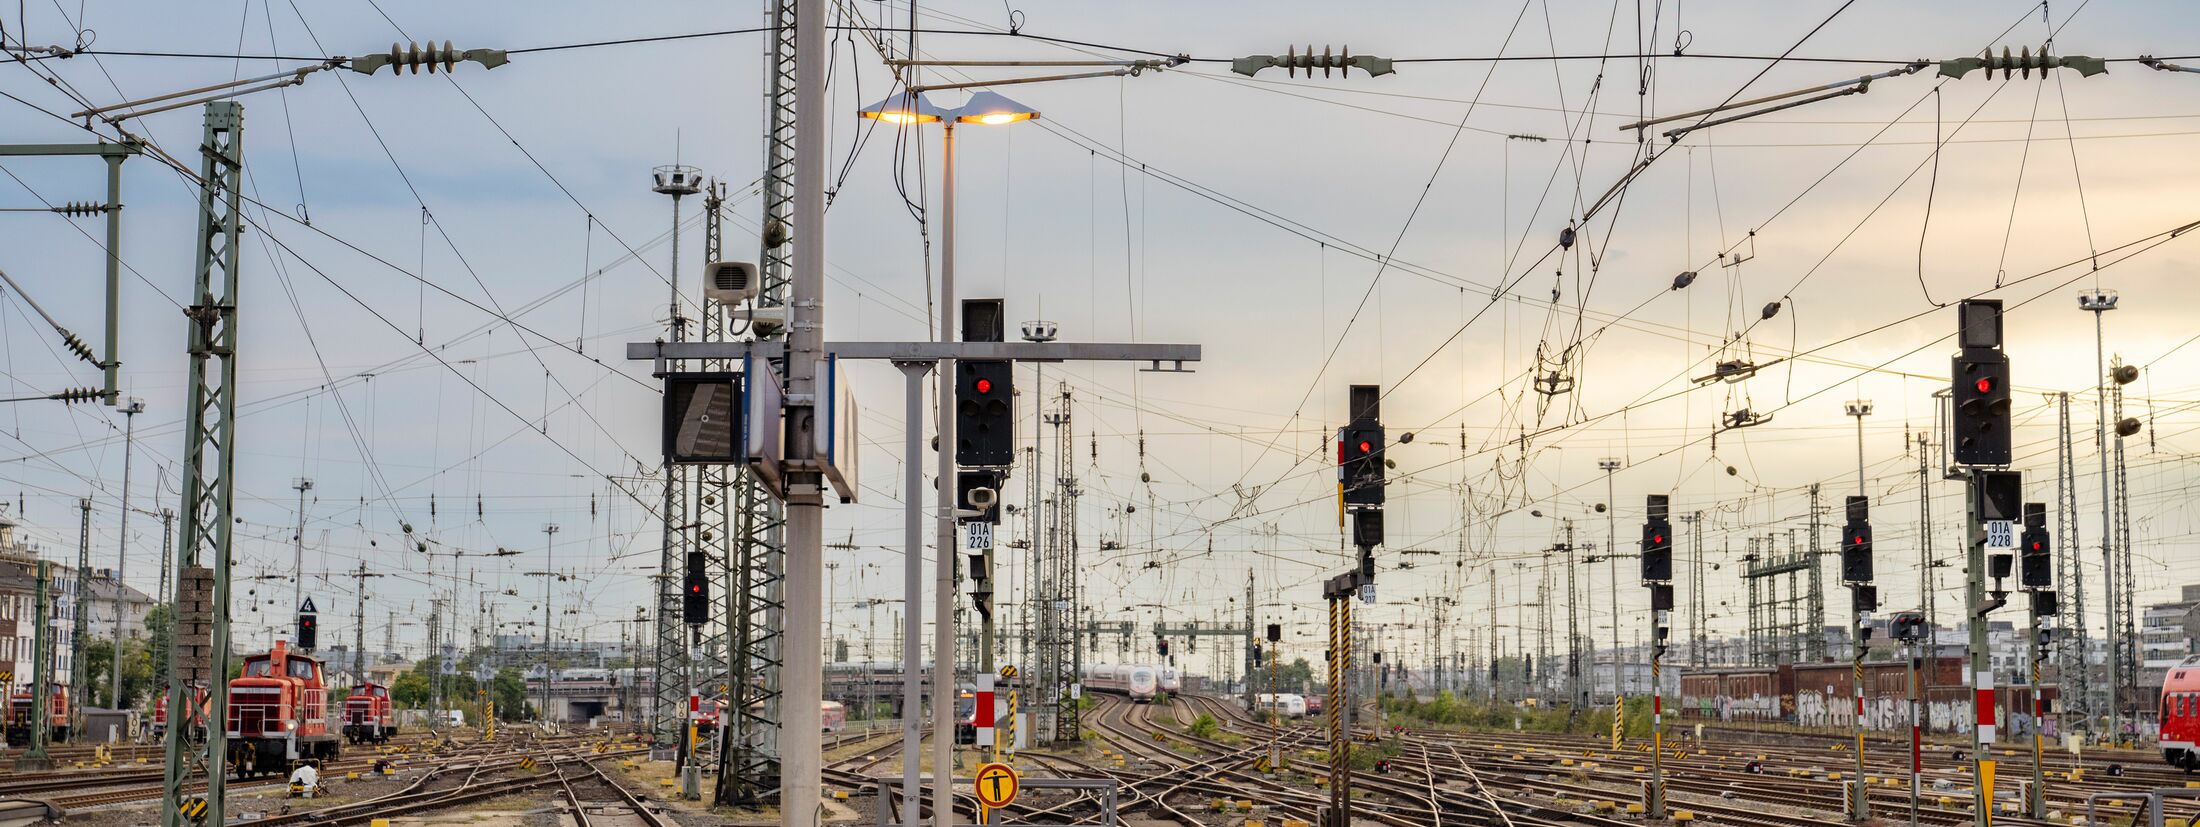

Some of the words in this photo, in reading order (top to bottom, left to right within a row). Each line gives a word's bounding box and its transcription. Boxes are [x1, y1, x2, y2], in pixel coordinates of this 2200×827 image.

[970, 523, 989, 535] 01A
[1991, 521, 2010, 534] 01A
[970, 536, 989, 549] 226
[1991, 534, 2011, 547] 228
[1363, 585, 1376, 594] 01A
[304, 600, 311, 611] 4
[1364, 595, 1376, 604] 217
